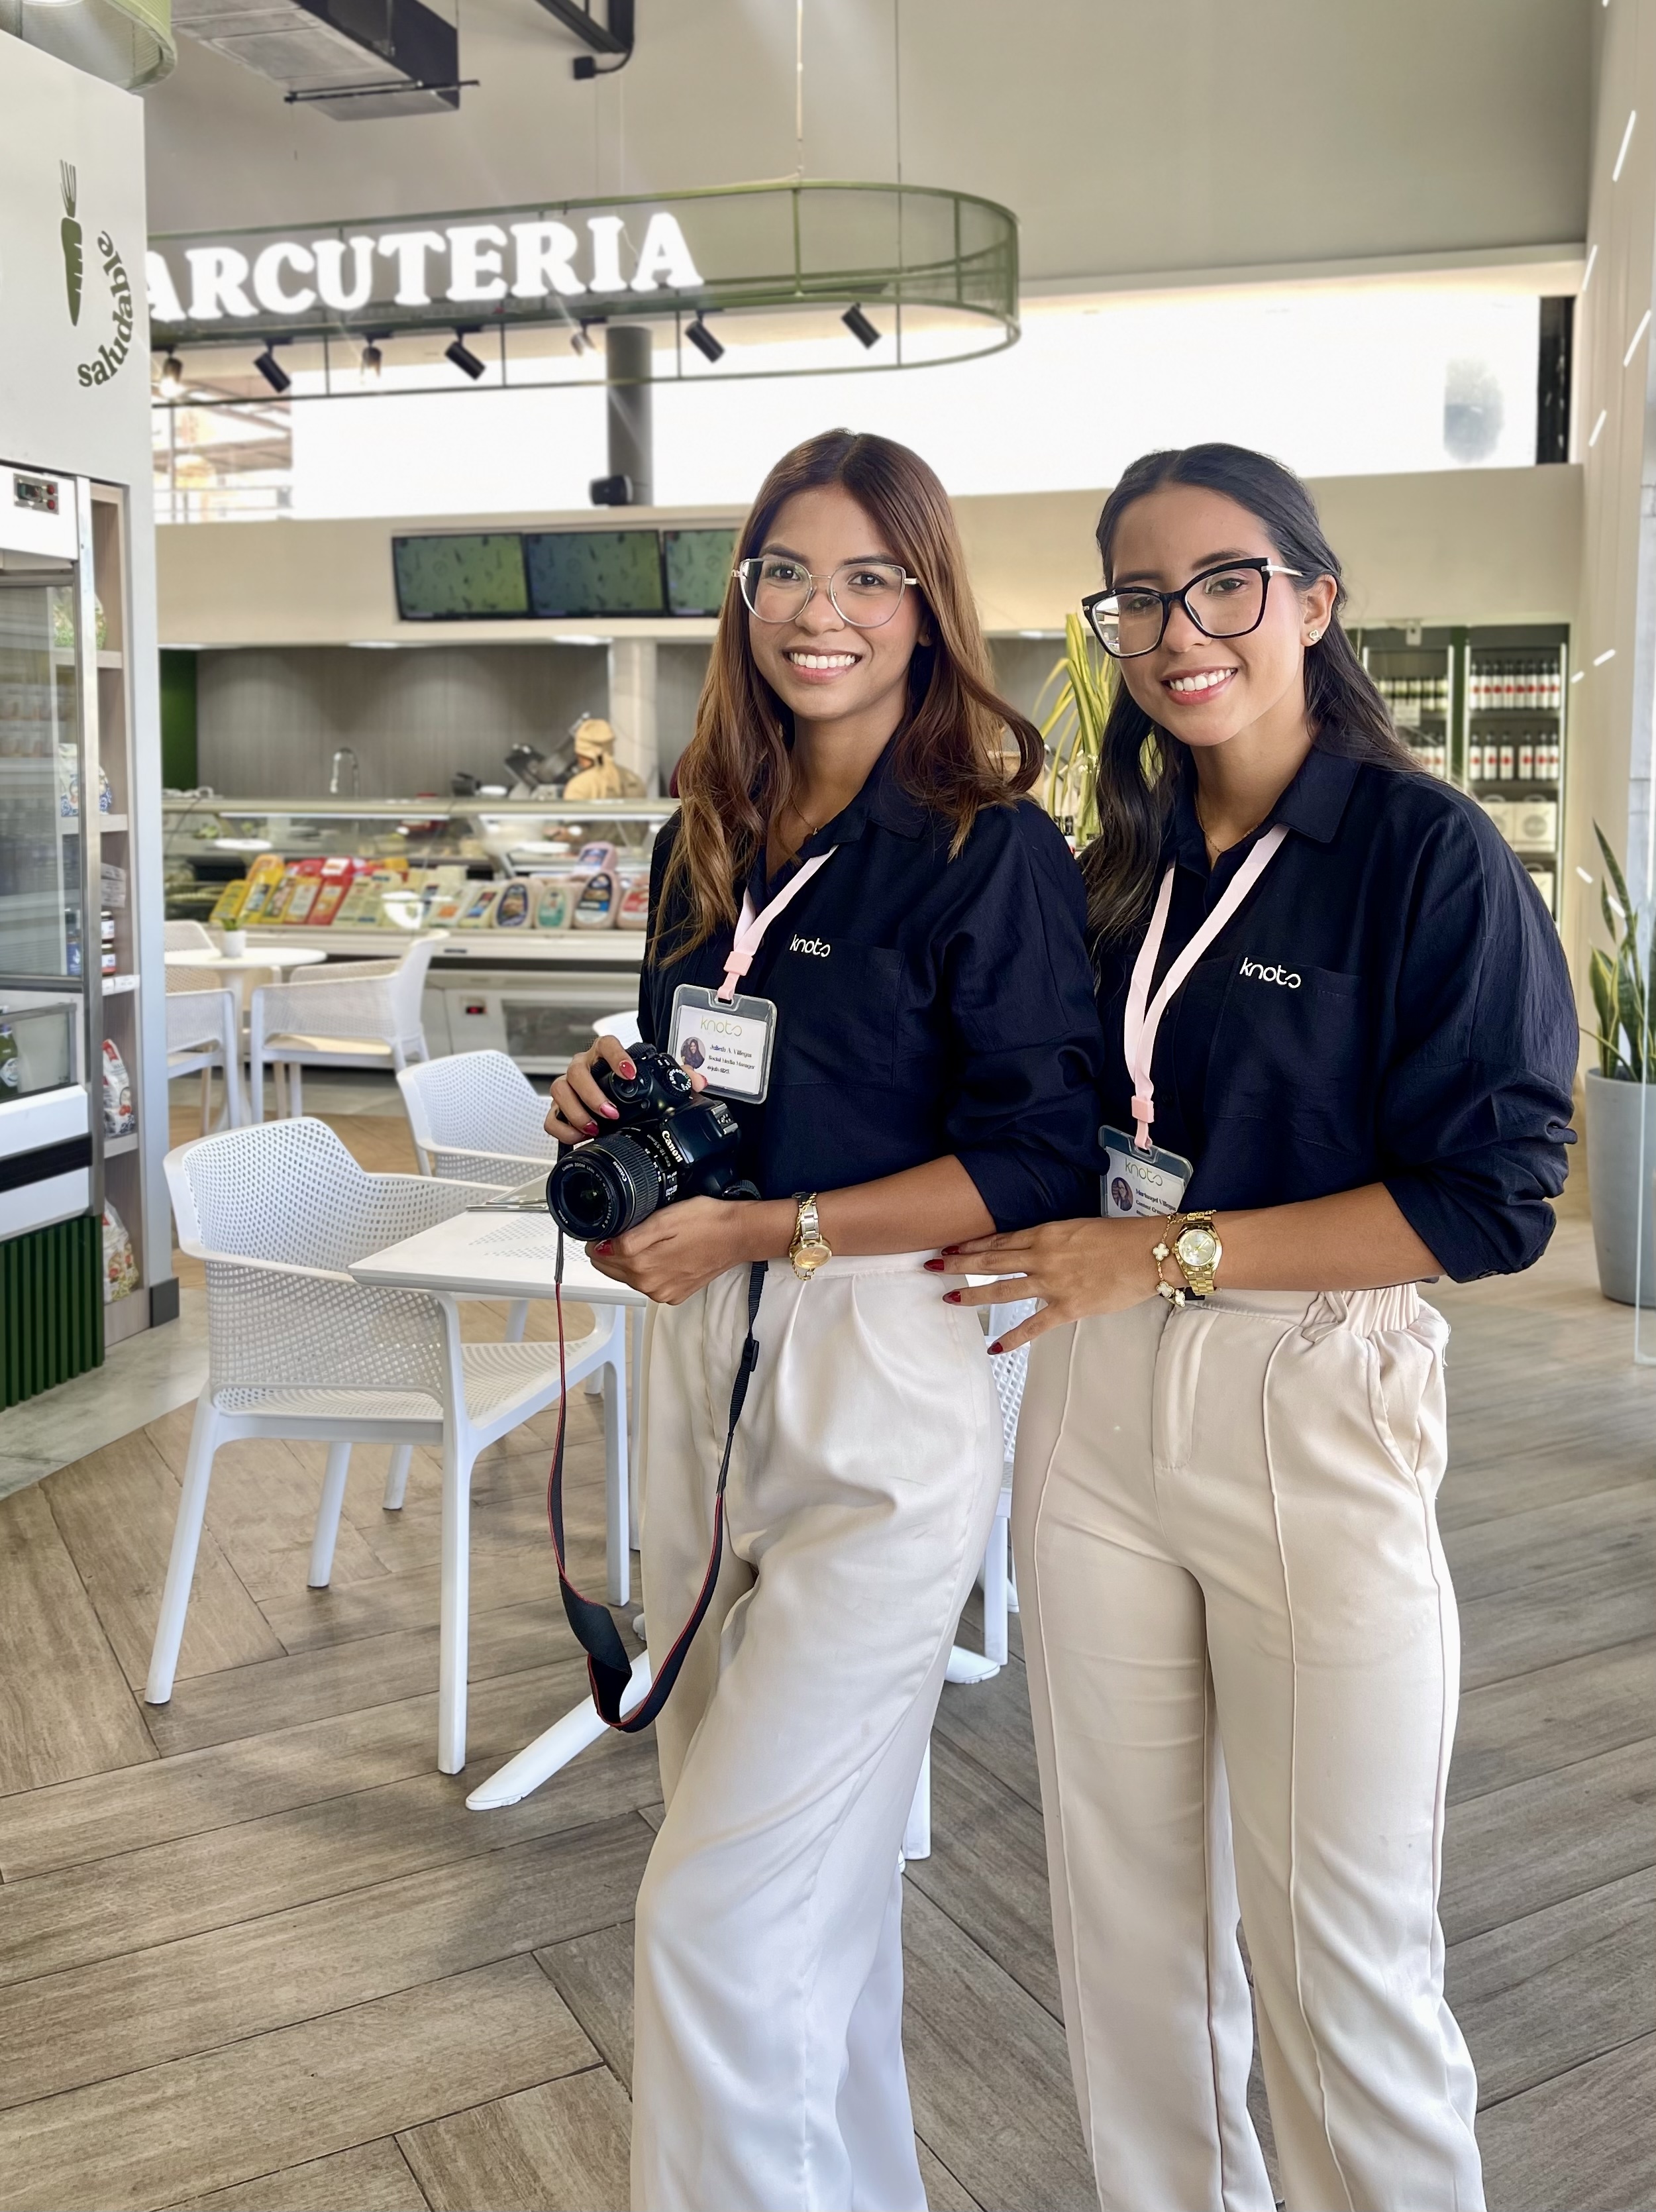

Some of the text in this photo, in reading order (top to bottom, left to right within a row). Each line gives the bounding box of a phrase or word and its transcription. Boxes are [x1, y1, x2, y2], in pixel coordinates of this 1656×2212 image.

[147, 212, 703, 321] ARCUTERIA
[78, 230, 133, 388] saludable
[790, 933, 831, 957] knots
[1239, 957, 1302, 988] knots
[700, 1015, 743, 1037] knots
[662, 1130, 683, 1162] Canon
[1125, 1157, 1163, 1186] knots
